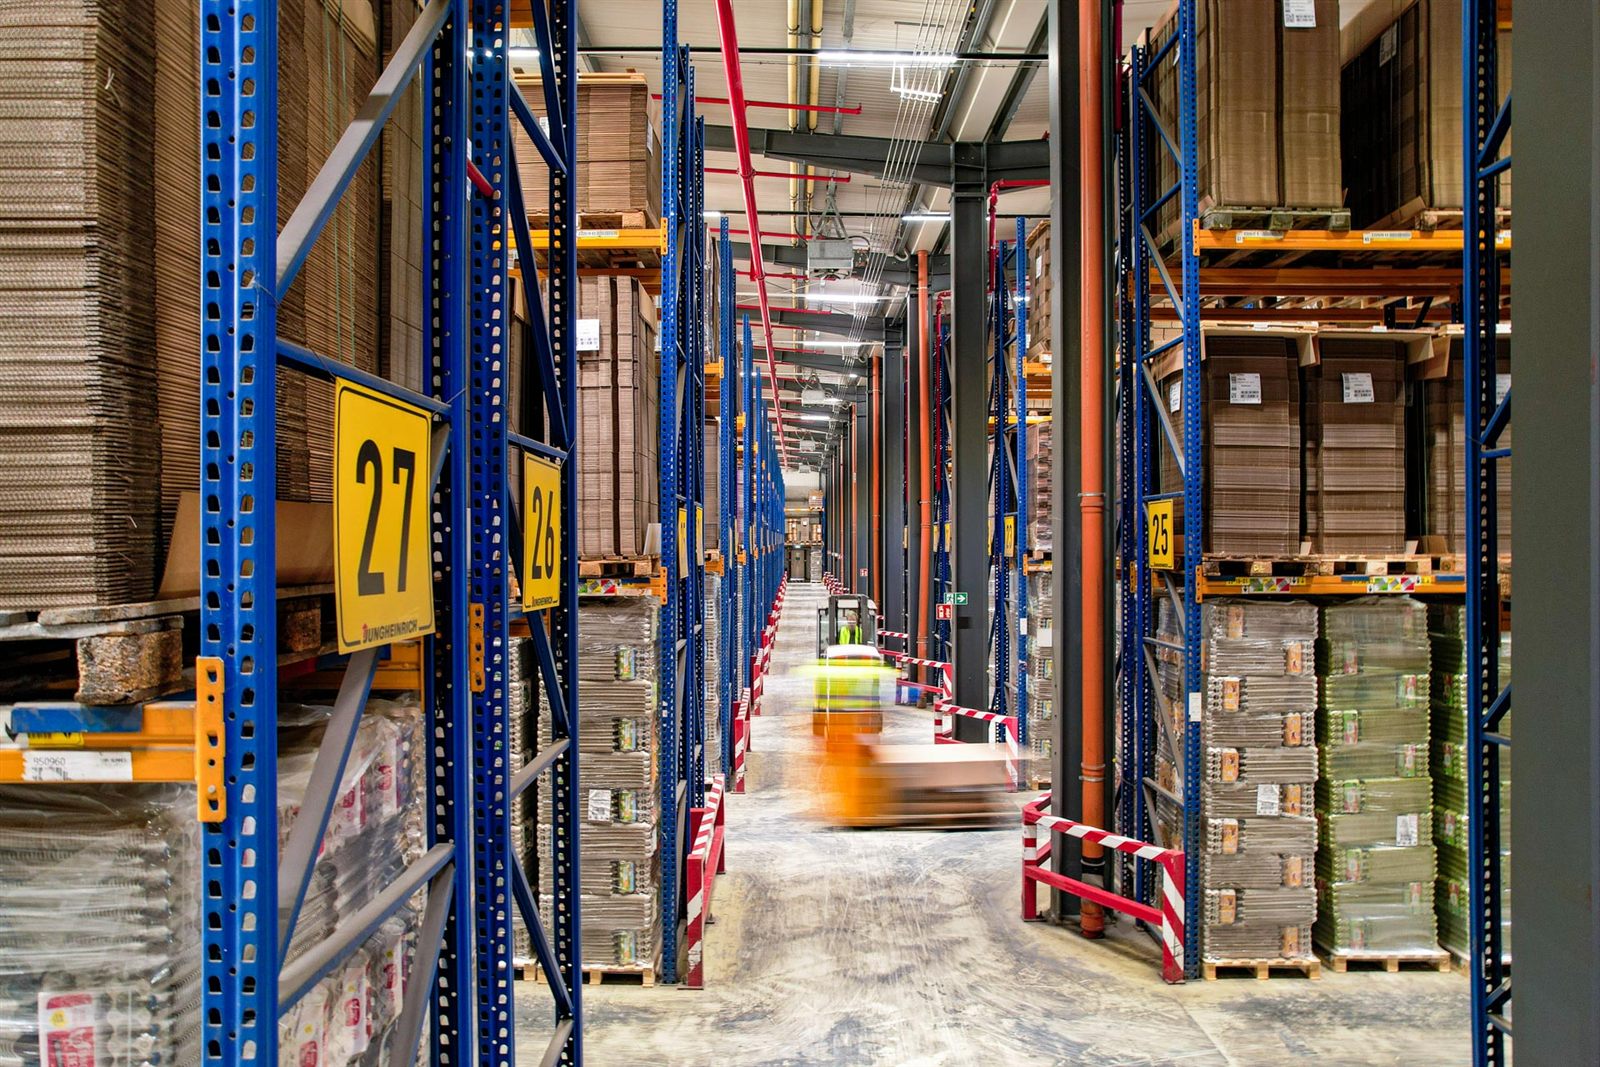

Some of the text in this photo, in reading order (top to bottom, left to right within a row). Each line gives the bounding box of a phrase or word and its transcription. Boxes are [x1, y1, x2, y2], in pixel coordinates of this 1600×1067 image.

[356, 439, 416, 596] 27
[532, 486, 554, 579] 26
[1153, 513, 1168, 555] 25
[362, 619, 418, 643] JUNGHEINRICH
